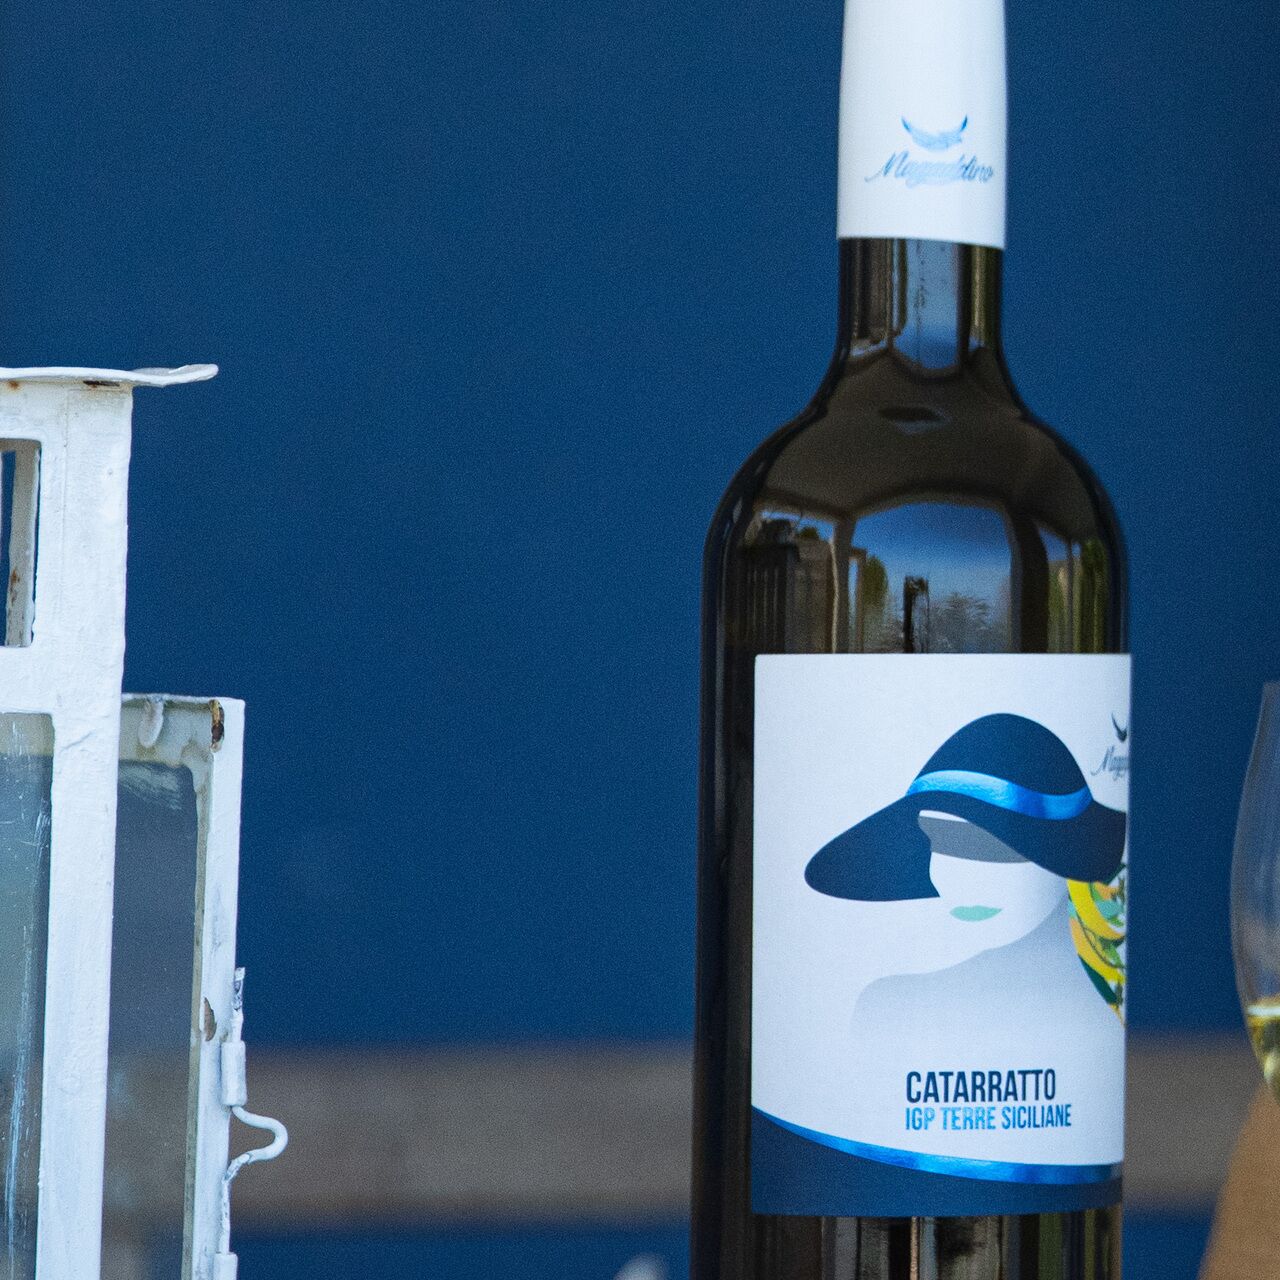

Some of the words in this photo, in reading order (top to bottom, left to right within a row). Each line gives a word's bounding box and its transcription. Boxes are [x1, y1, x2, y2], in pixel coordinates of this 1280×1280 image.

[906, 1068, 1056, 1104] CATARRATTO
[905, 1107, 936, 1130] IGP
[940, 1107, 996, 1130] TERRE
[1001, 1104, 1072, 1130] SICILIANE
